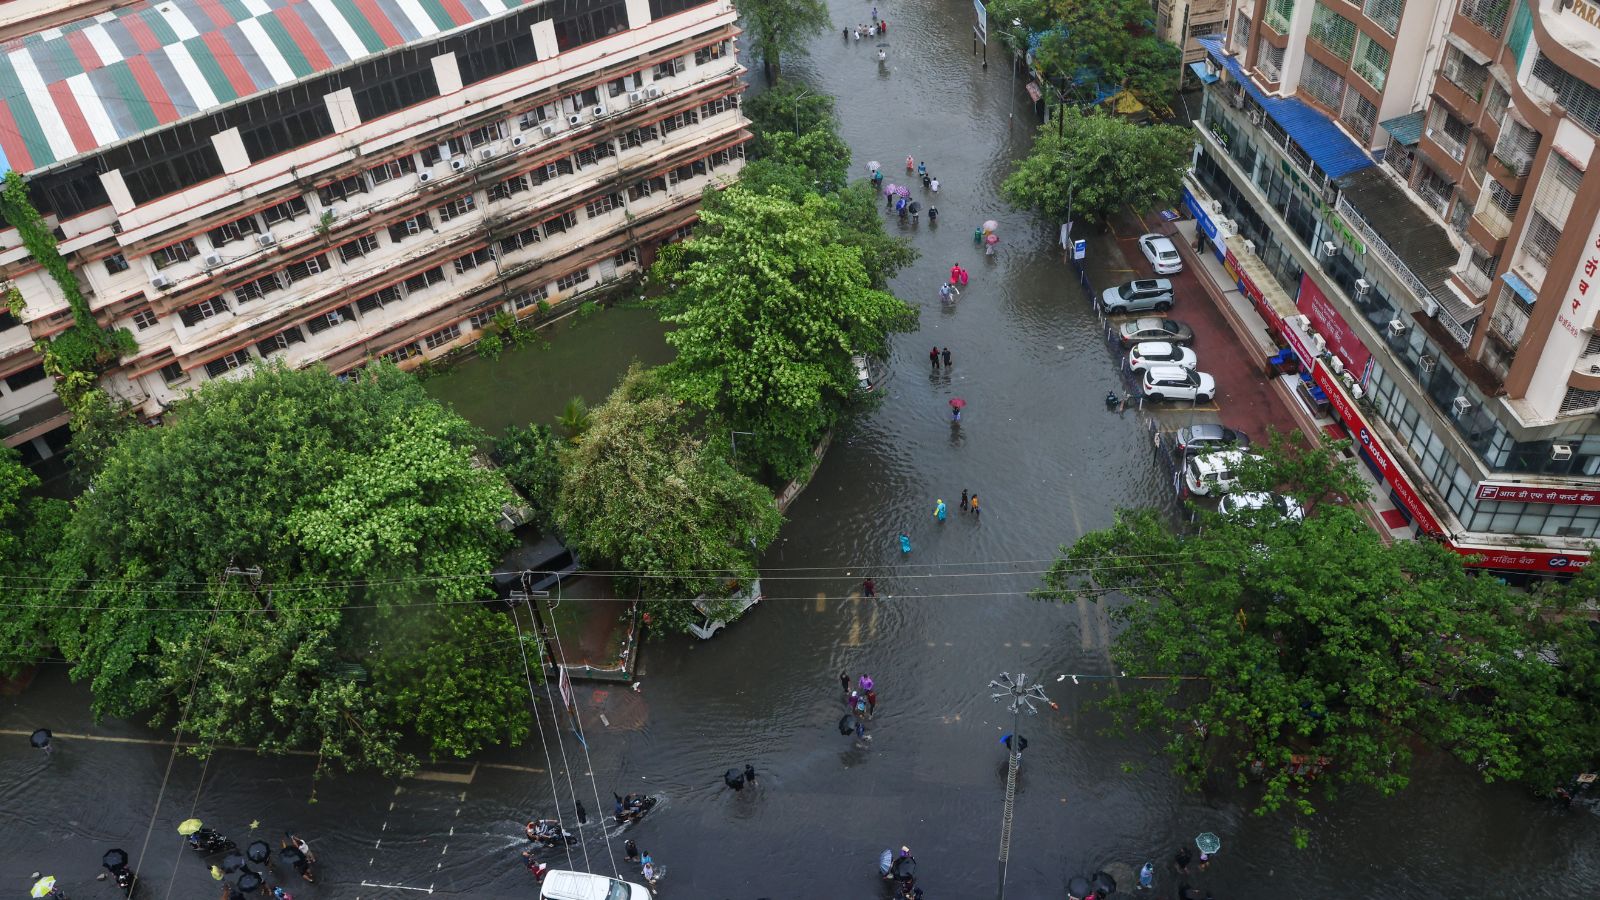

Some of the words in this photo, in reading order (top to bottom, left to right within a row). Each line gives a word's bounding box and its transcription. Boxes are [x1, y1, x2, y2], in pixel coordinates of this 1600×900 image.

[1368, 441, 1388, 470] kotak
[1518, 490, 1528, 498] डी
[1546, 492, 1557, 500] सी
